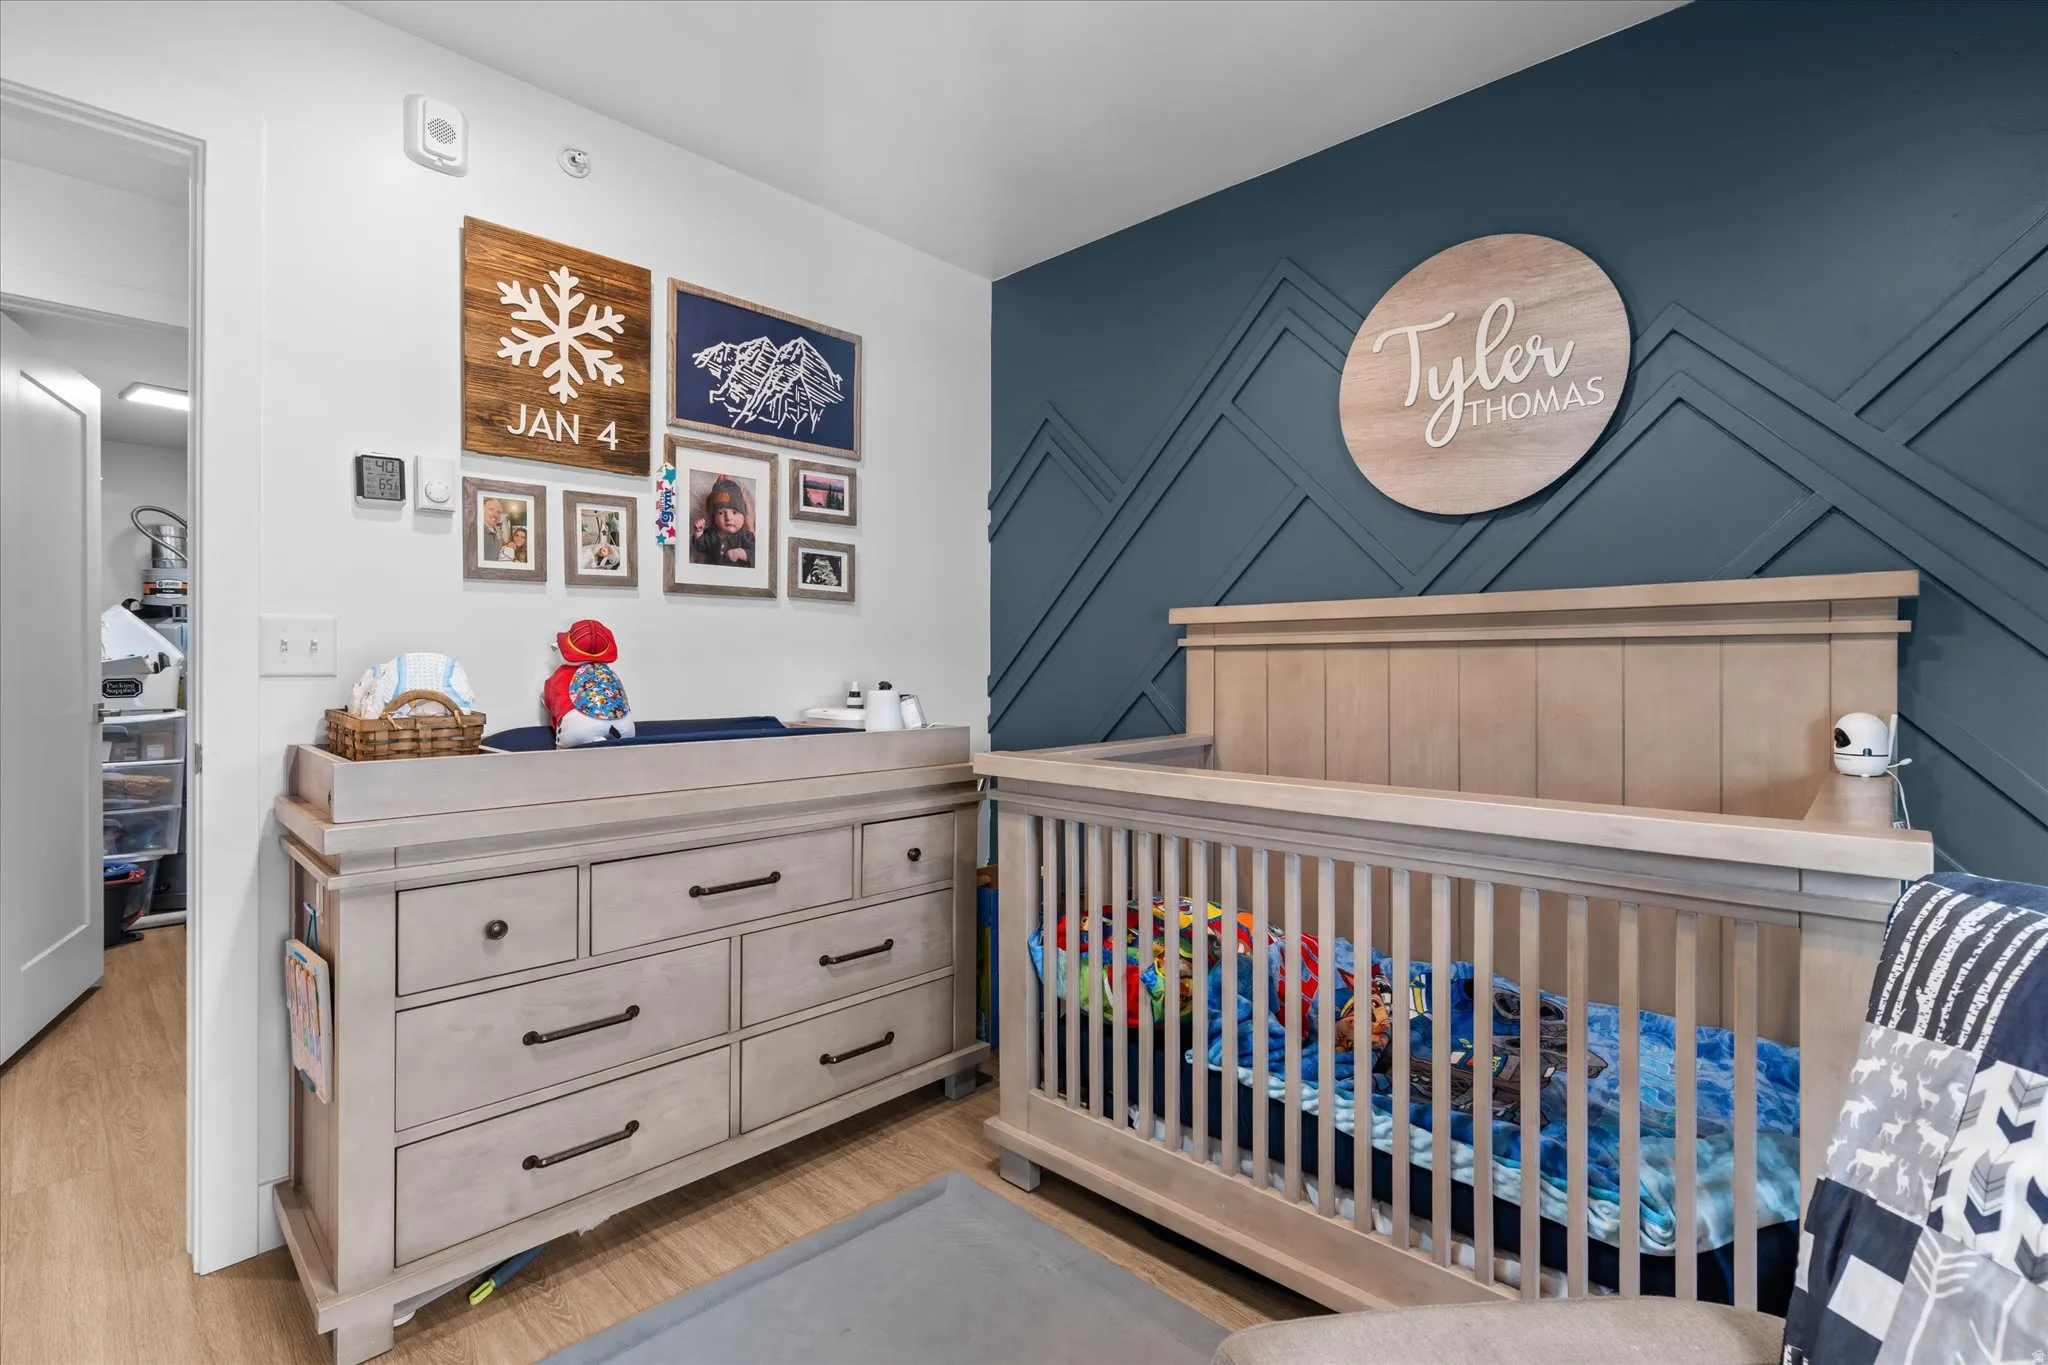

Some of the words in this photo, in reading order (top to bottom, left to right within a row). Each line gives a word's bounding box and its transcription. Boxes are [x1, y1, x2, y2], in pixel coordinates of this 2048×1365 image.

[1372, 296, 1576, 448] Tyler
[506, 403, 580, 445] JAN
[596, 421, 619, 451] 4
[1465, 375, 1606, 427] THOMAS
